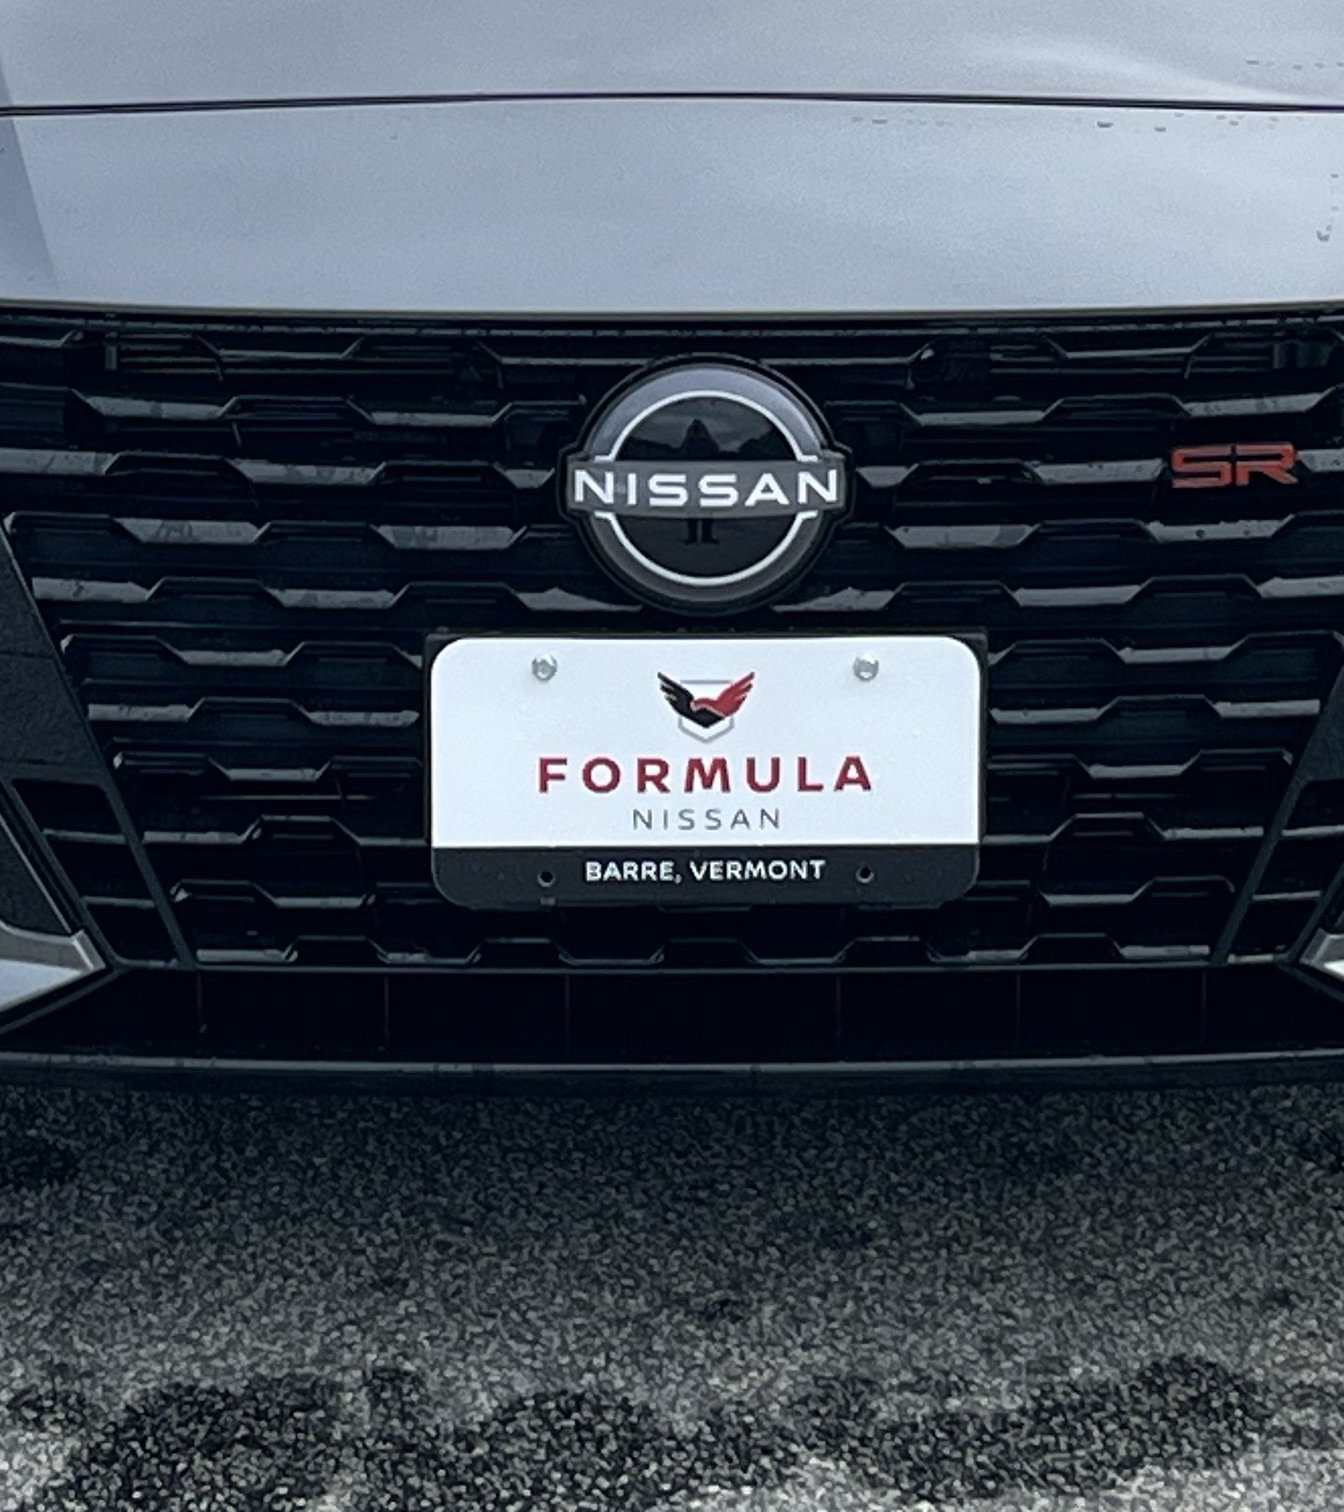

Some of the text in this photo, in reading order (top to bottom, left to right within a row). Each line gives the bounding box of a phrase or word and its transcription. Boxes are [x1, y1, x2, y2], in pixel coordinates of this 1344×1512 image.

[1171, 442, 1299, 488] SR
[574, 469, 838, 507] NISSAN
[537, 755, 872, 793] FORMULA
[632, 807, 780, 831] NISSAN
[585, 858, 826, 884] BARRE, VERMONT
